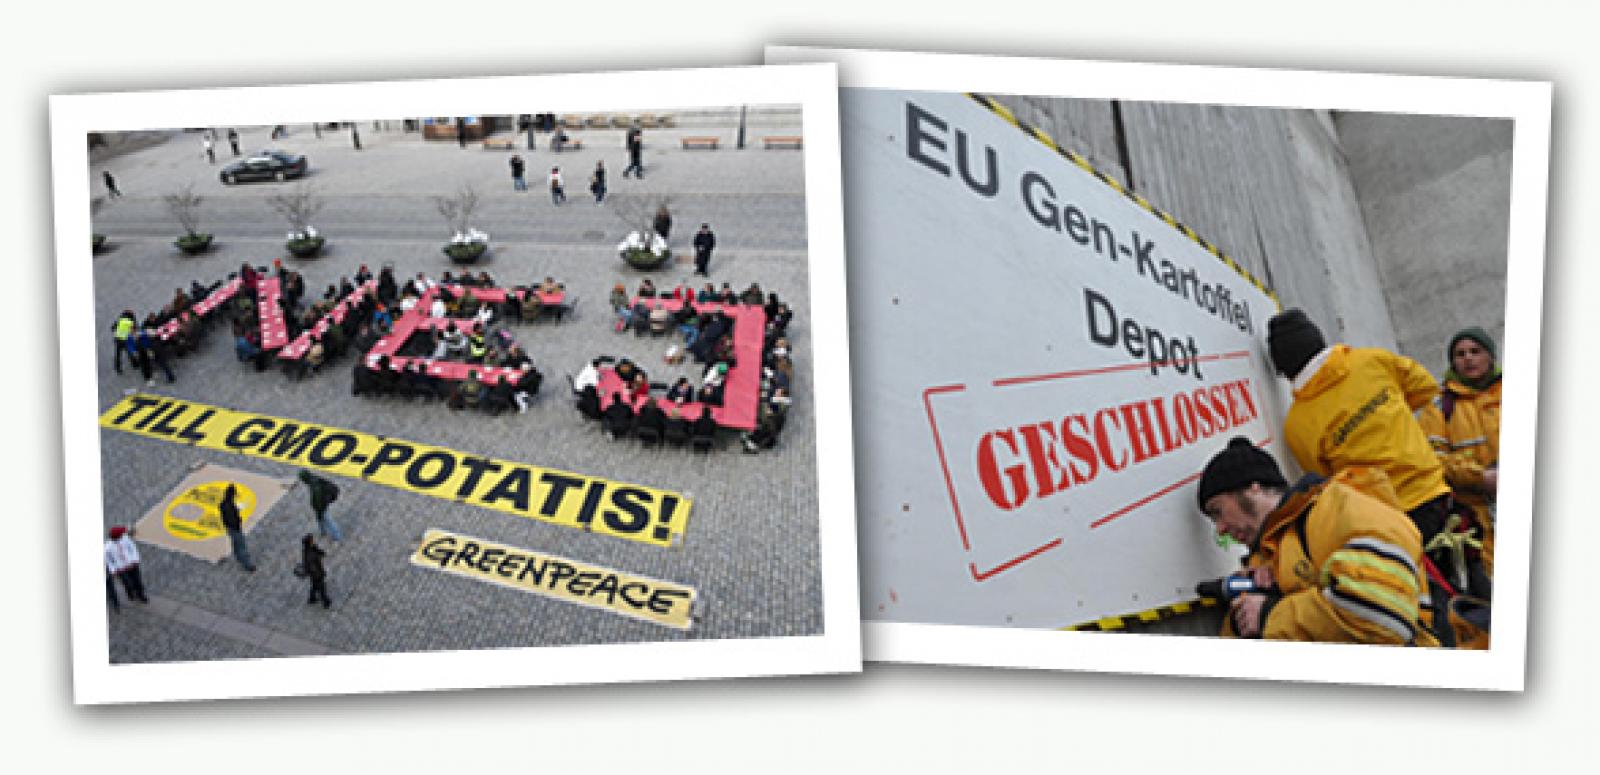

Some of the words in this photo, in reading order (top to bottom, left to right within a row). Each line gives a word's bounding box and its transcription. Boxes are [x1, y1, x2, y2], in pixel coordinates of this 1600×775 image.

[905, 101, 999, 198] EU
[1021, 171, 1254, 335] Gen-Kartoffel
[1084, 287, 1204, 381] Depot
[111, 396, 208, 441] TILL
[224, 418, 679, 541] GMO-POTATIS!
[976, 378, 1258, 511] GESCHLOSSEN
[421, 536, 691, 615] GREENPEACE
